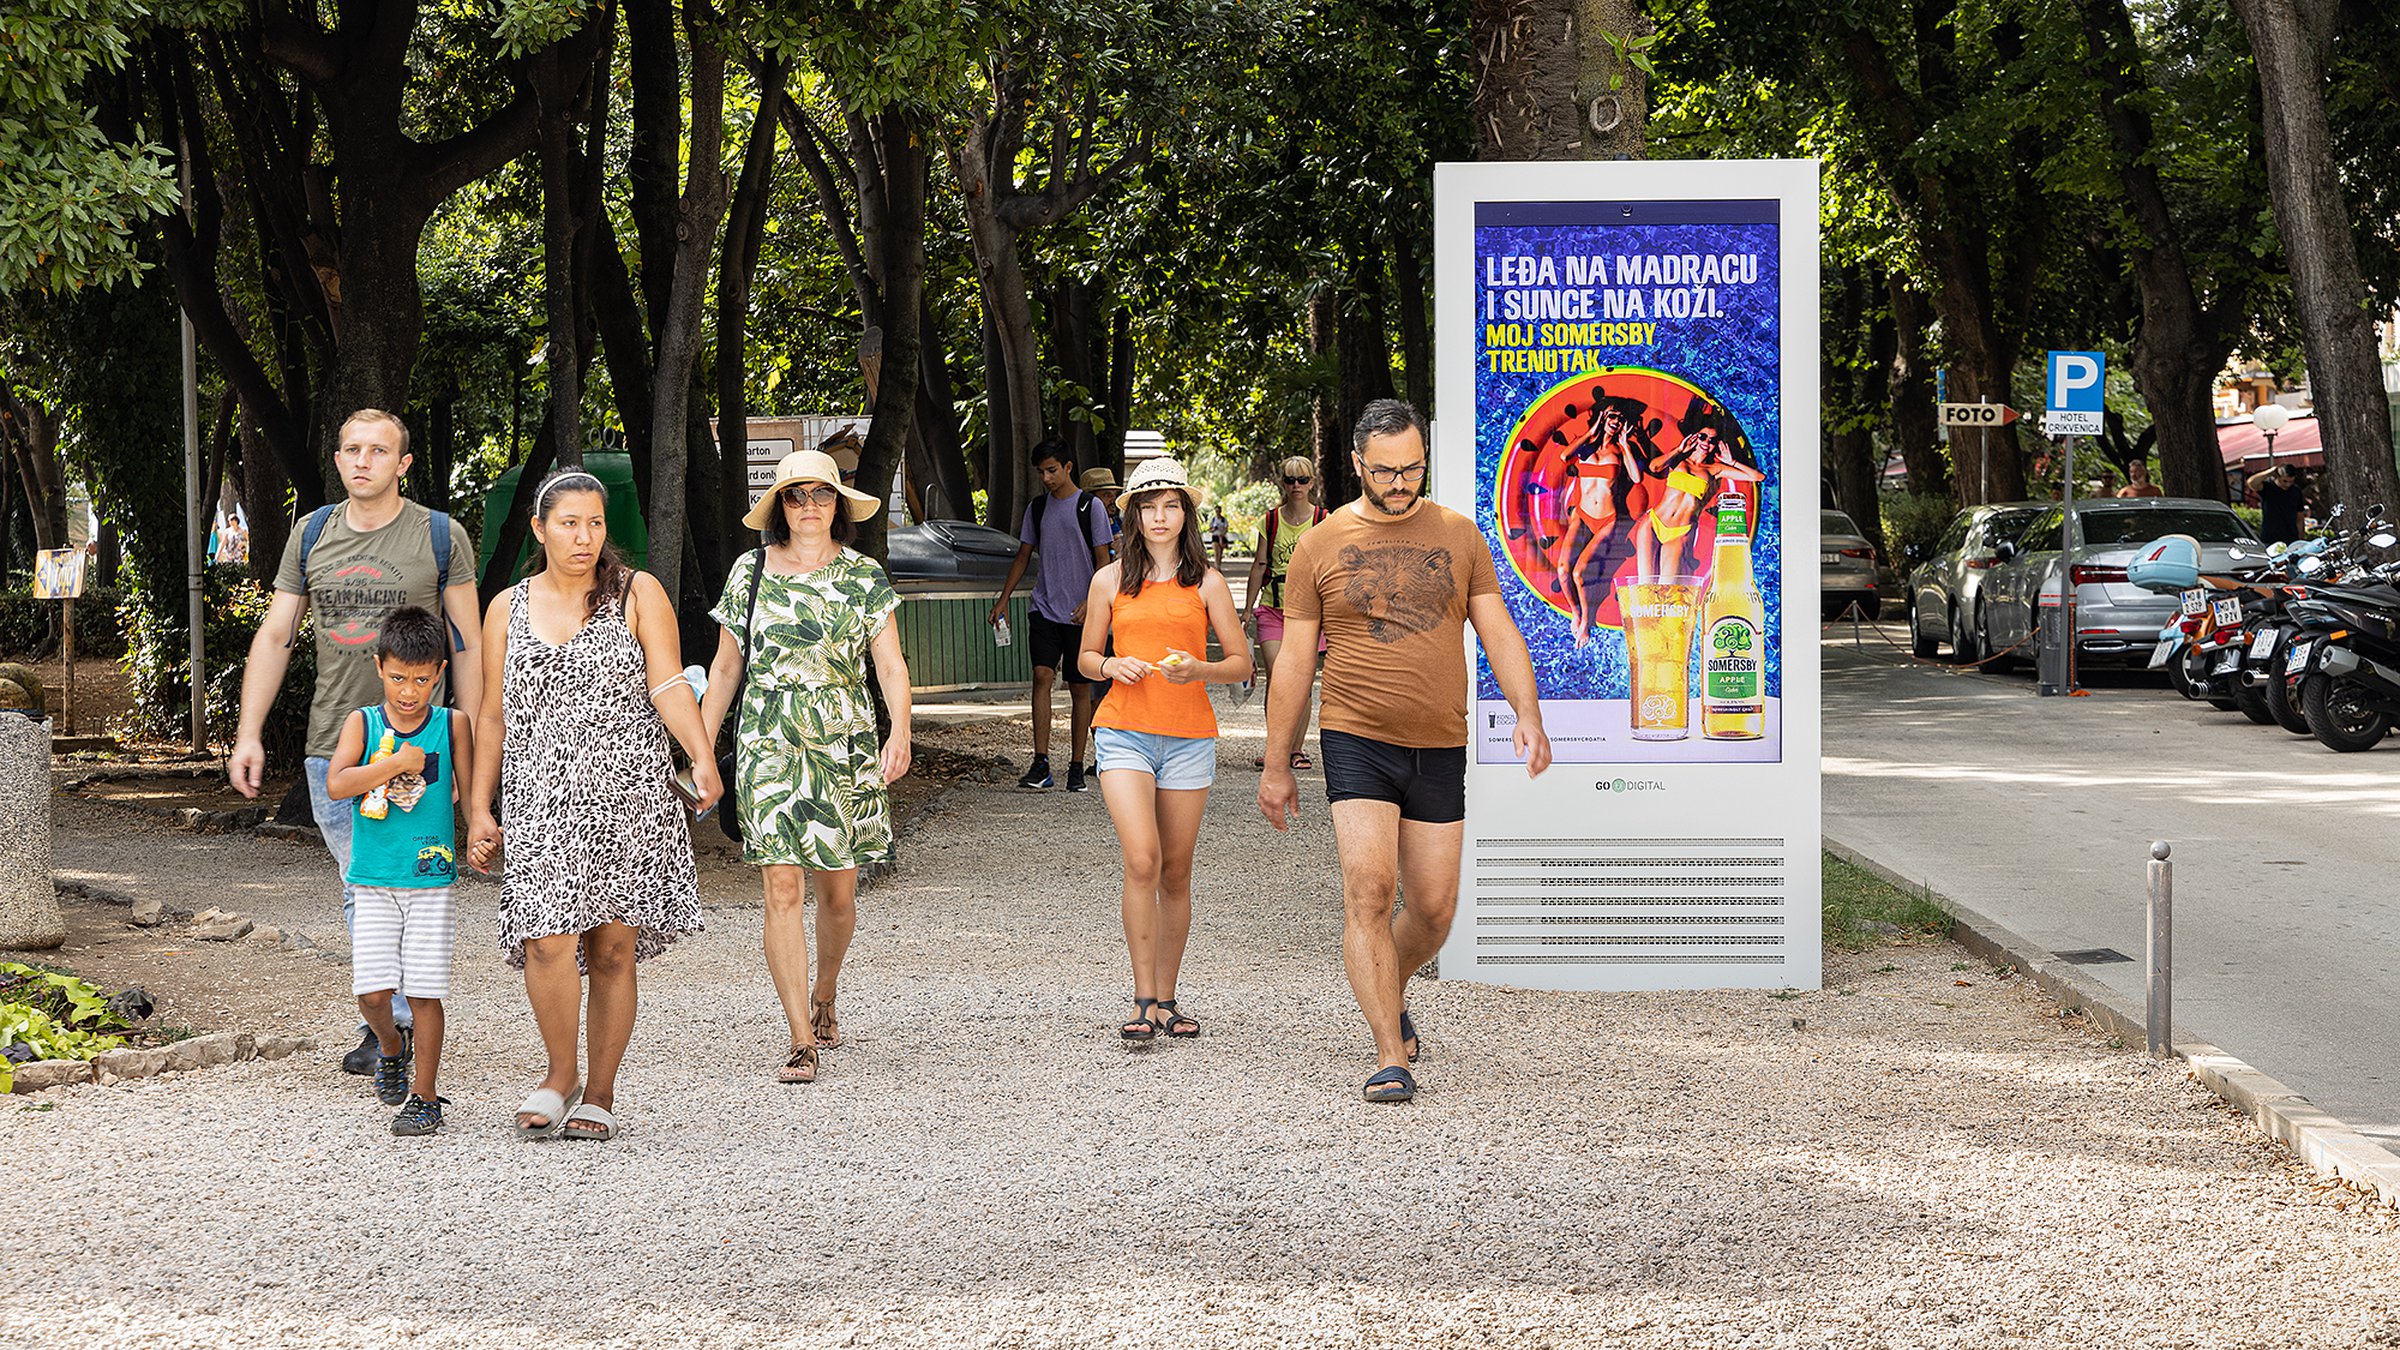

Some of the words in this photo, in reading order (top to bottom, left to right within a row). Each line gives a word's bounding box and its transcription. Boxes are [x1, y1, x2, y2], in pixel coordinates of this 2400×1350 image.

[1486, 255, 1558, 286] LEĐA
[1566, 256, 1608, 285] NA
[1616, 253, 1758, 285] MADRACU
[1486, 290, 1495, 320] I
[1504, 288, 1595, 320] SUNCE
[1603, 288, 1646, 319] NA
[1654, 283, 1725, 319] KOŽI.
[1485, 323, 1534, 348] MOJ
[1540, 322, 1657, 346] SOMERSBY
[2055, 354, 2099, 409] P
[1946, 407, 1996, 423] FOTO
[2060, 413, 2088, 423] HOTEL
[2048, 424, 2100, 434] CRIKVENICA
[746, 447, 770, 456] arton
[749, 470, 759, 479] rd
[1721, 515, 1744, 523] APPLE
[355, 589, 407, 605] RACING
[1630, 604, 1689, 618] SOMERSBY
[1708, 659, 1757, 672] SOMERSBY
[1719, 676, 1745, 684] APPLE
